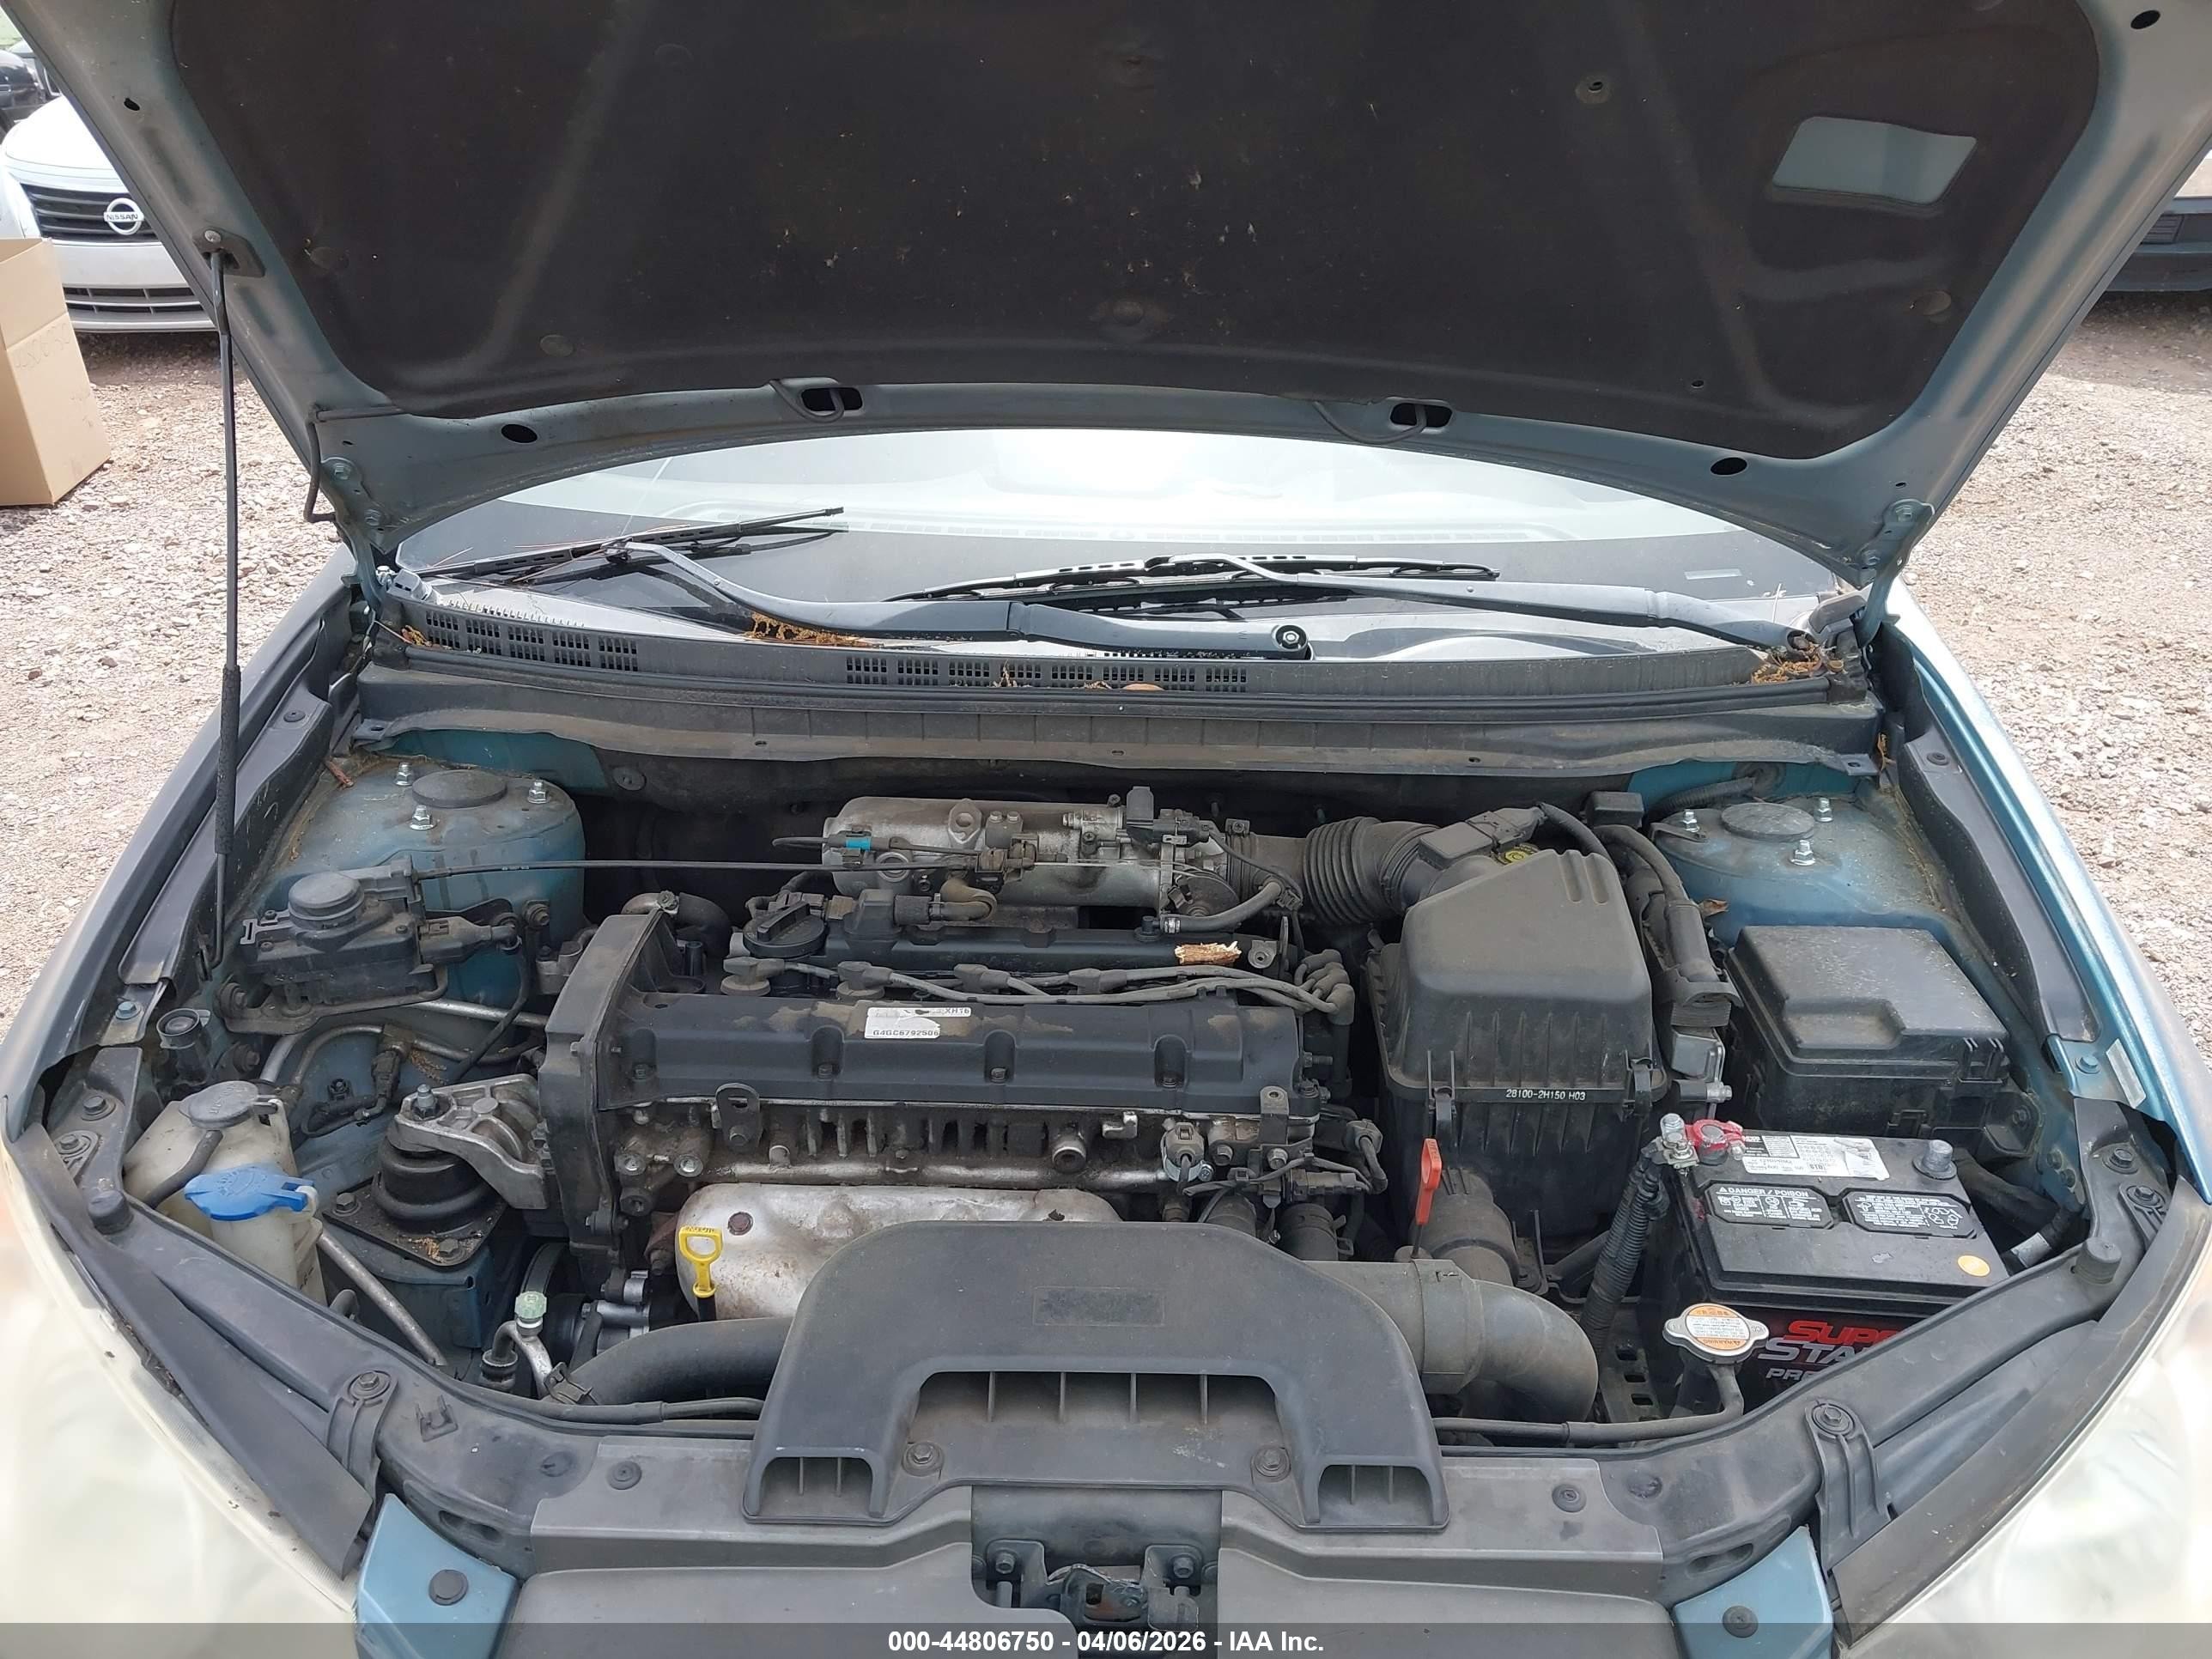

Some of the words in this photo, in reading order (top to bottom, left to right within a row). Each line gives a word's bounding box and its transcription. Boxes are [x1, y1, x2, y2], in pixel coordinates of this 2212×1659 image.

[1505, 1088, 1566, 1099] 28100-2H150
[1568, 1091, 1586, 1101] H03
[1728, 1187, 1765, 1195] DANGER
[1774, 1188, 1809, 1198] POISON
[1758, 1336, 1870, 1364] STA
